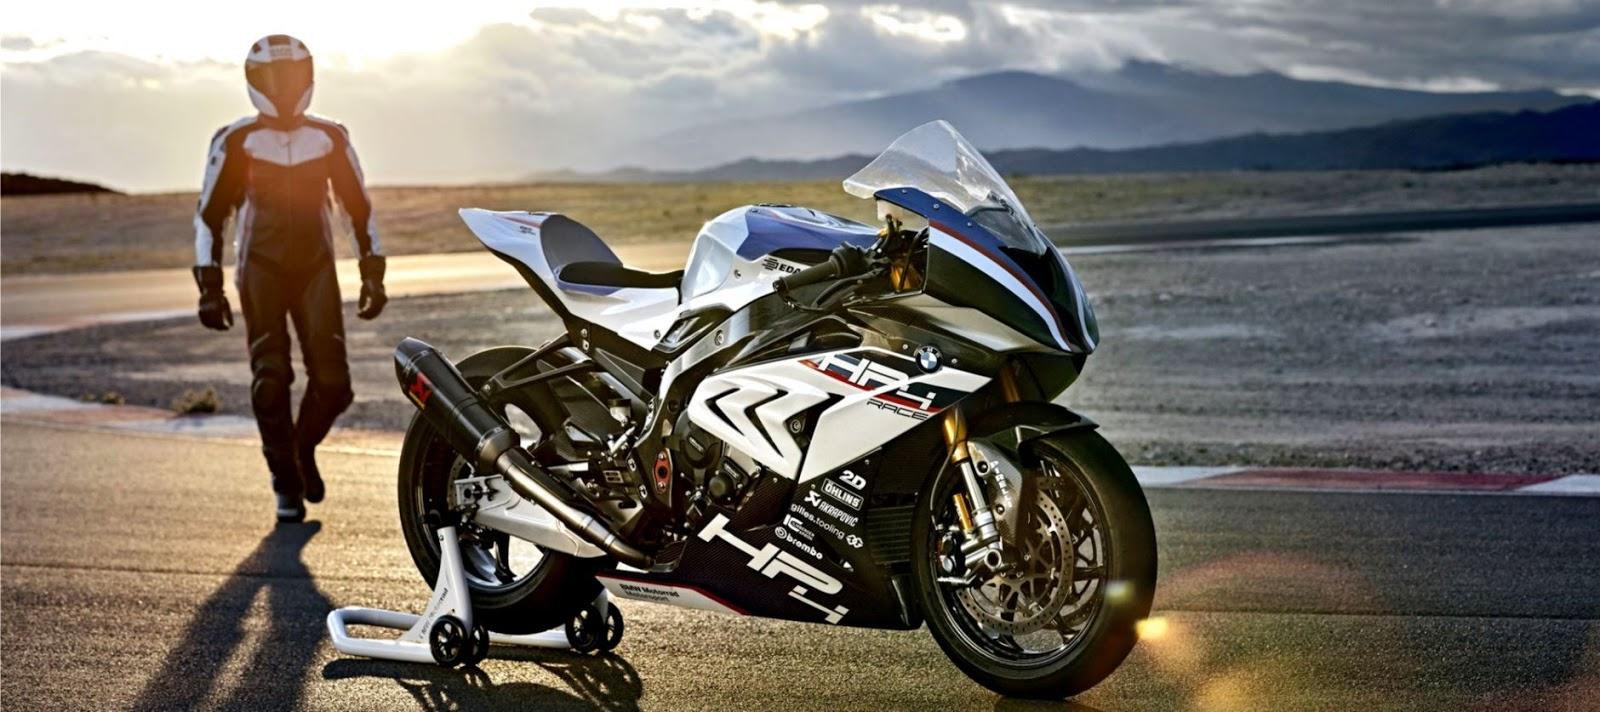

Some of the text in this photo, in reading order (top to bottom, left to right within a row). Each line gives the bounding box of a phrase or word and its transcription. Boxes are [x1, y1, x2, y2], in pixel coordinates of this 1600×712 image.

[779, 263, 801, 274] EDA
[817, 354, 937, 411] HP4
[867, 398, 929, 421] RACE
[839, 469, 866, 490] 2D
[790, 503, 845, 540] gilles.tooling
[786, 533, 824, 560] brembo
[697, 512, 850, 625] HP4
[619, 583, 680, 598] BMW Motorrad
